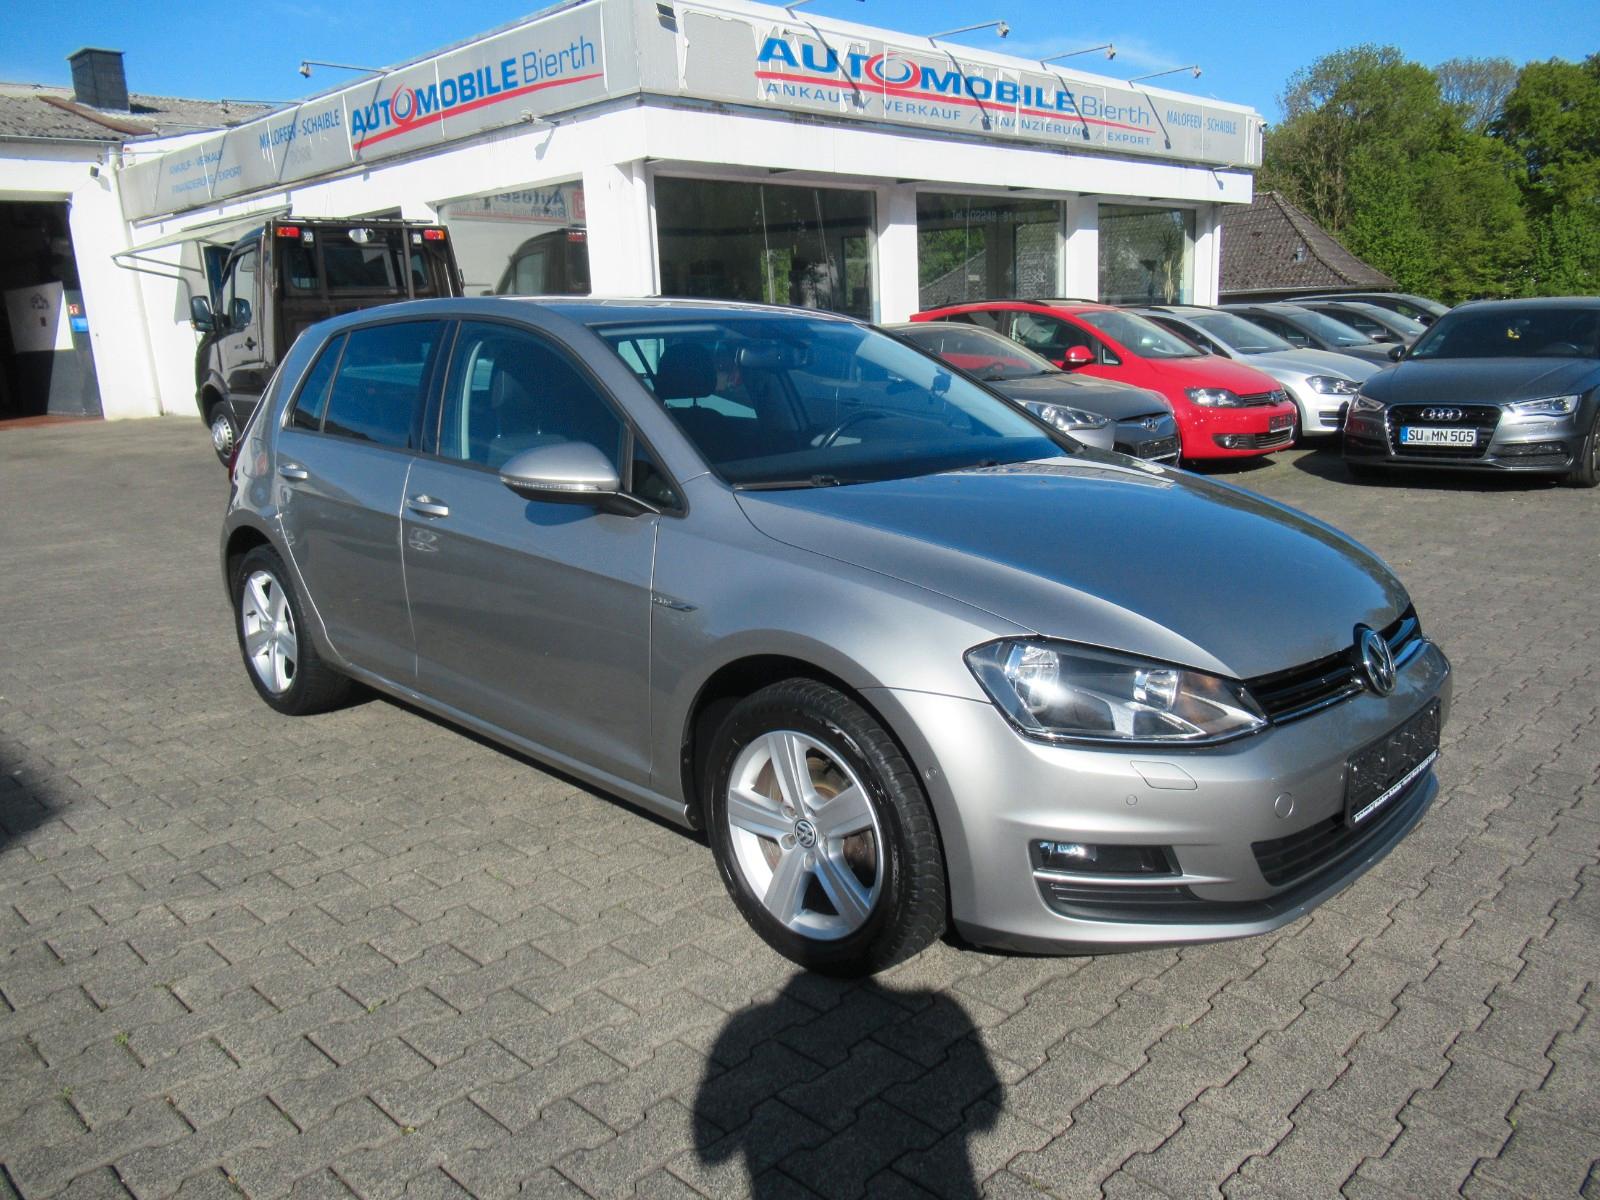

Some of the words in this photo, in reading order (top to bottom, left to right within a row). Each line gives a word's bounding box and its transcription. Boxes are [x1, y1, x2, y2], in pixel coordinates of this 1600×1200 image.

[352, 57, 518, 135] AUTOMOBILE
[522, 36, 596, 84] Bierth
[757, 37, 1076, 112] AUTOMOBILE
[1081, 95, 1150, 127] Bierth
[302, 109, 340, 135] SCHAIBLE
[766, 83, 853, 103] ANKAUF
[882, 99, 961, 121] VERKAUF
[1107, 131, 1151, 145] EXPORT
[1207, 117, 1237, 135] SCHAIBLE
[1408, 429, 1424, 441] SU
[1431, 430, 1448, 442] MN
[1450, 431, 1474, 442] 505
